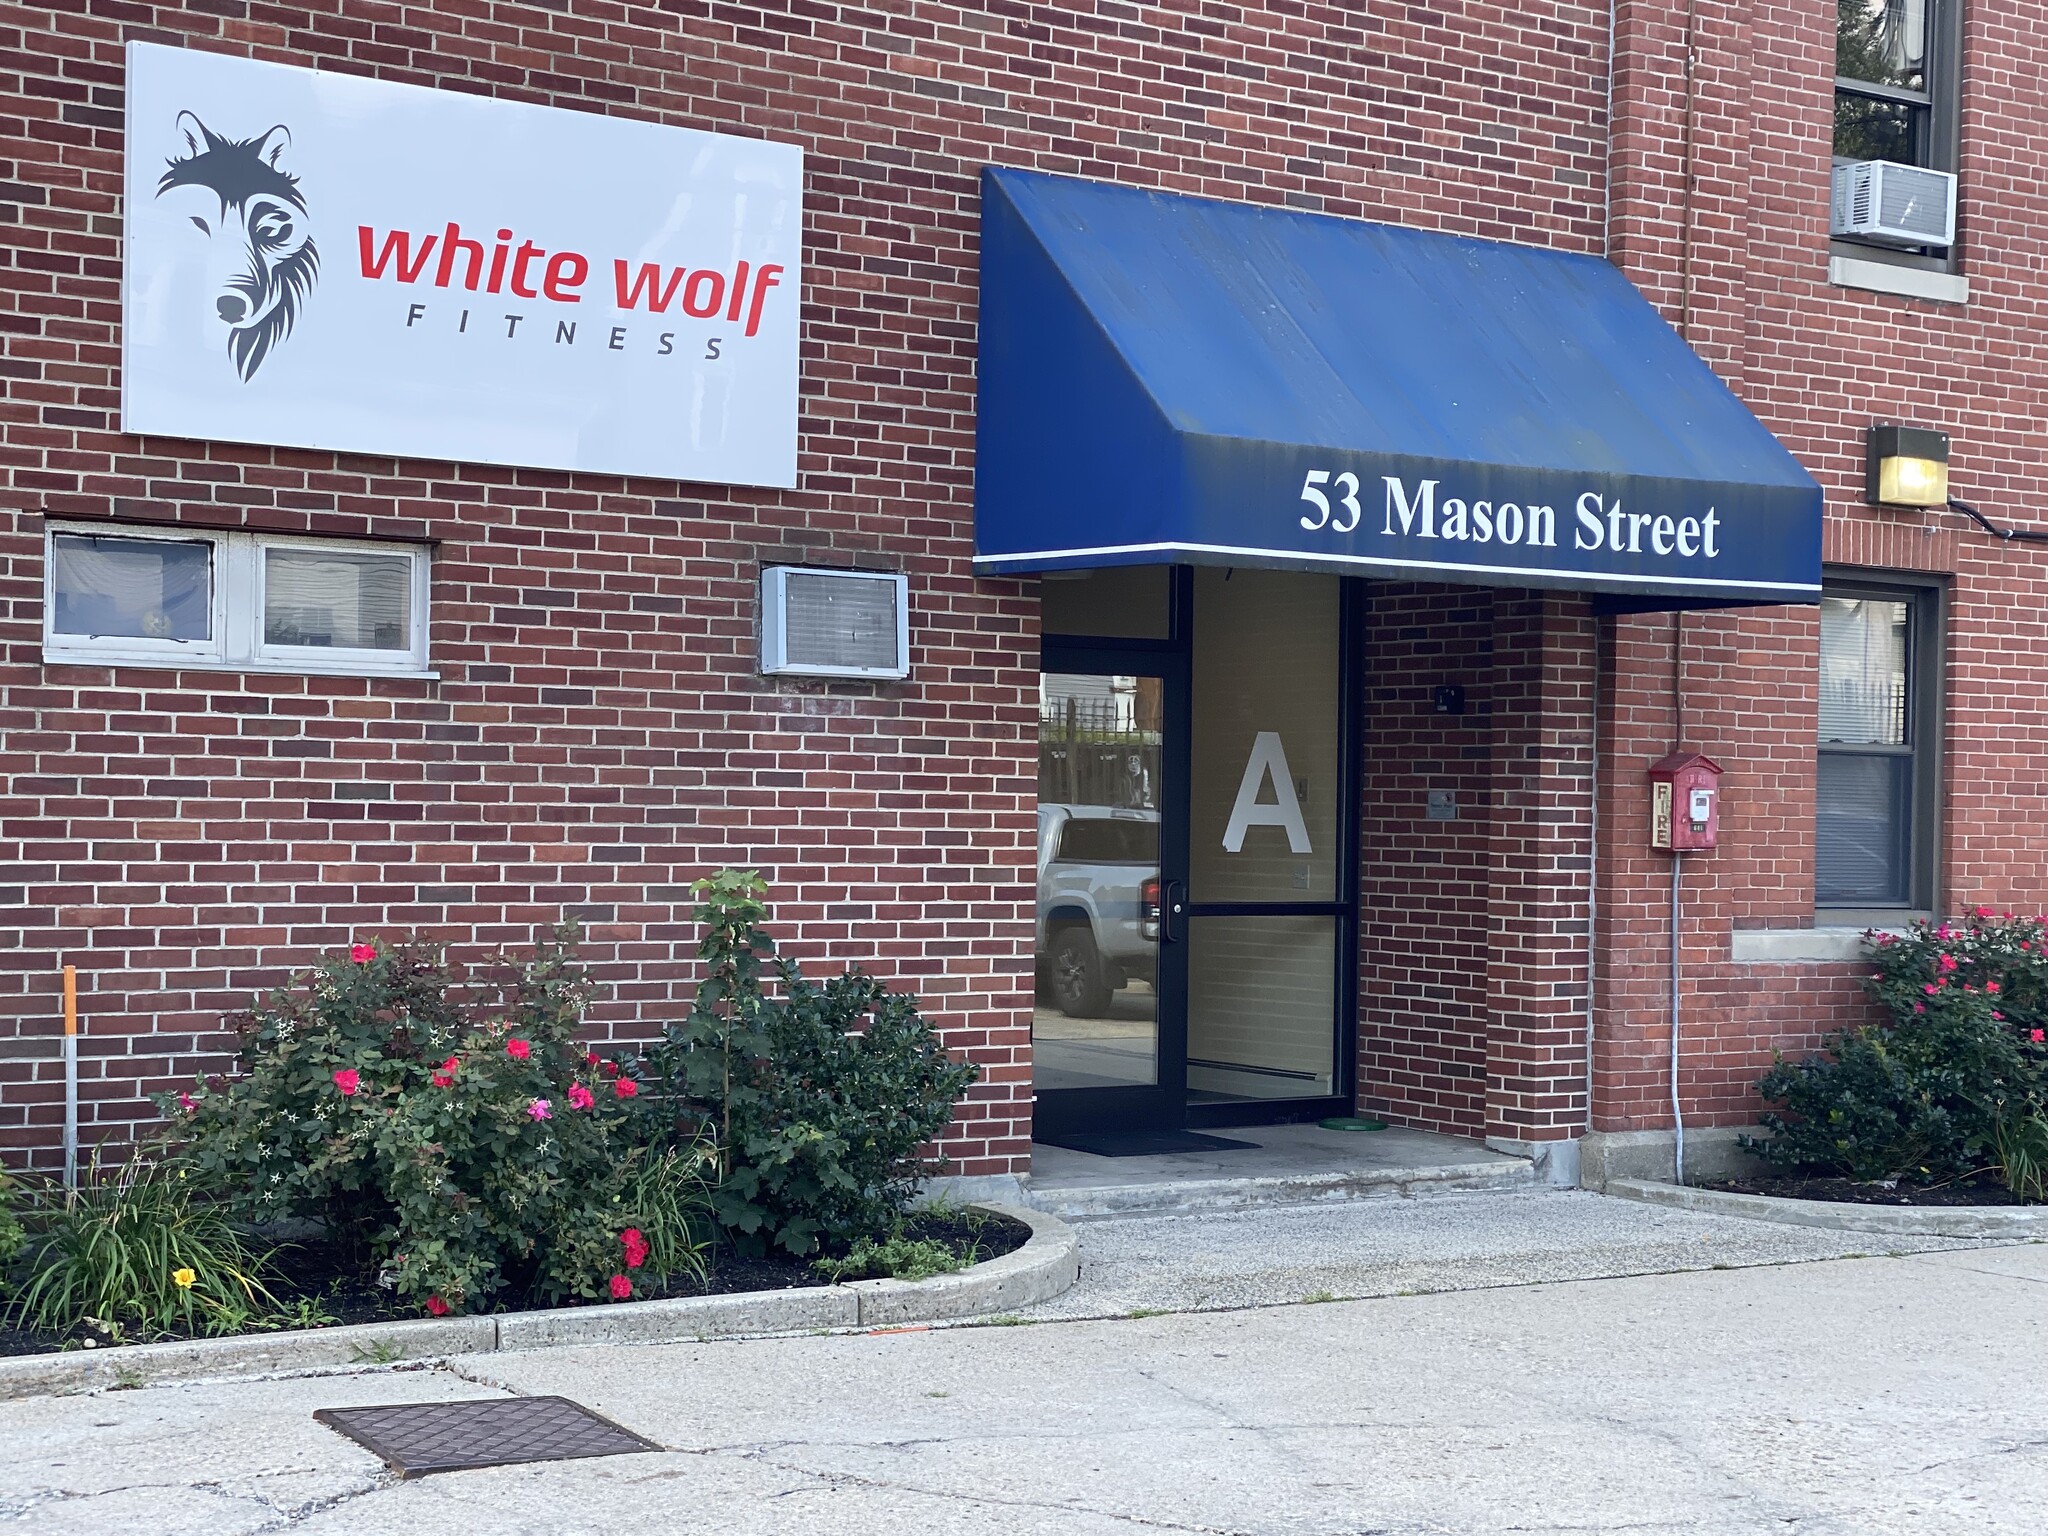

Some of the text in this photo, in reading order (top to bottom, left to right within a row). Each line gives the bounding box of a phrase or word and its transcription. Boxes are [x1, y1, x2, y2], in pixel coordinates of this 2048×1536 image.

[358, 222, 784, 337] white wolf
[406, 303, 723, 361] FITNESS
[1300, 469, 1721, 558] 53 Mason Street
[1222, 731, 1313, 854] A
[1657, 785, 1668, 843] FIRE
